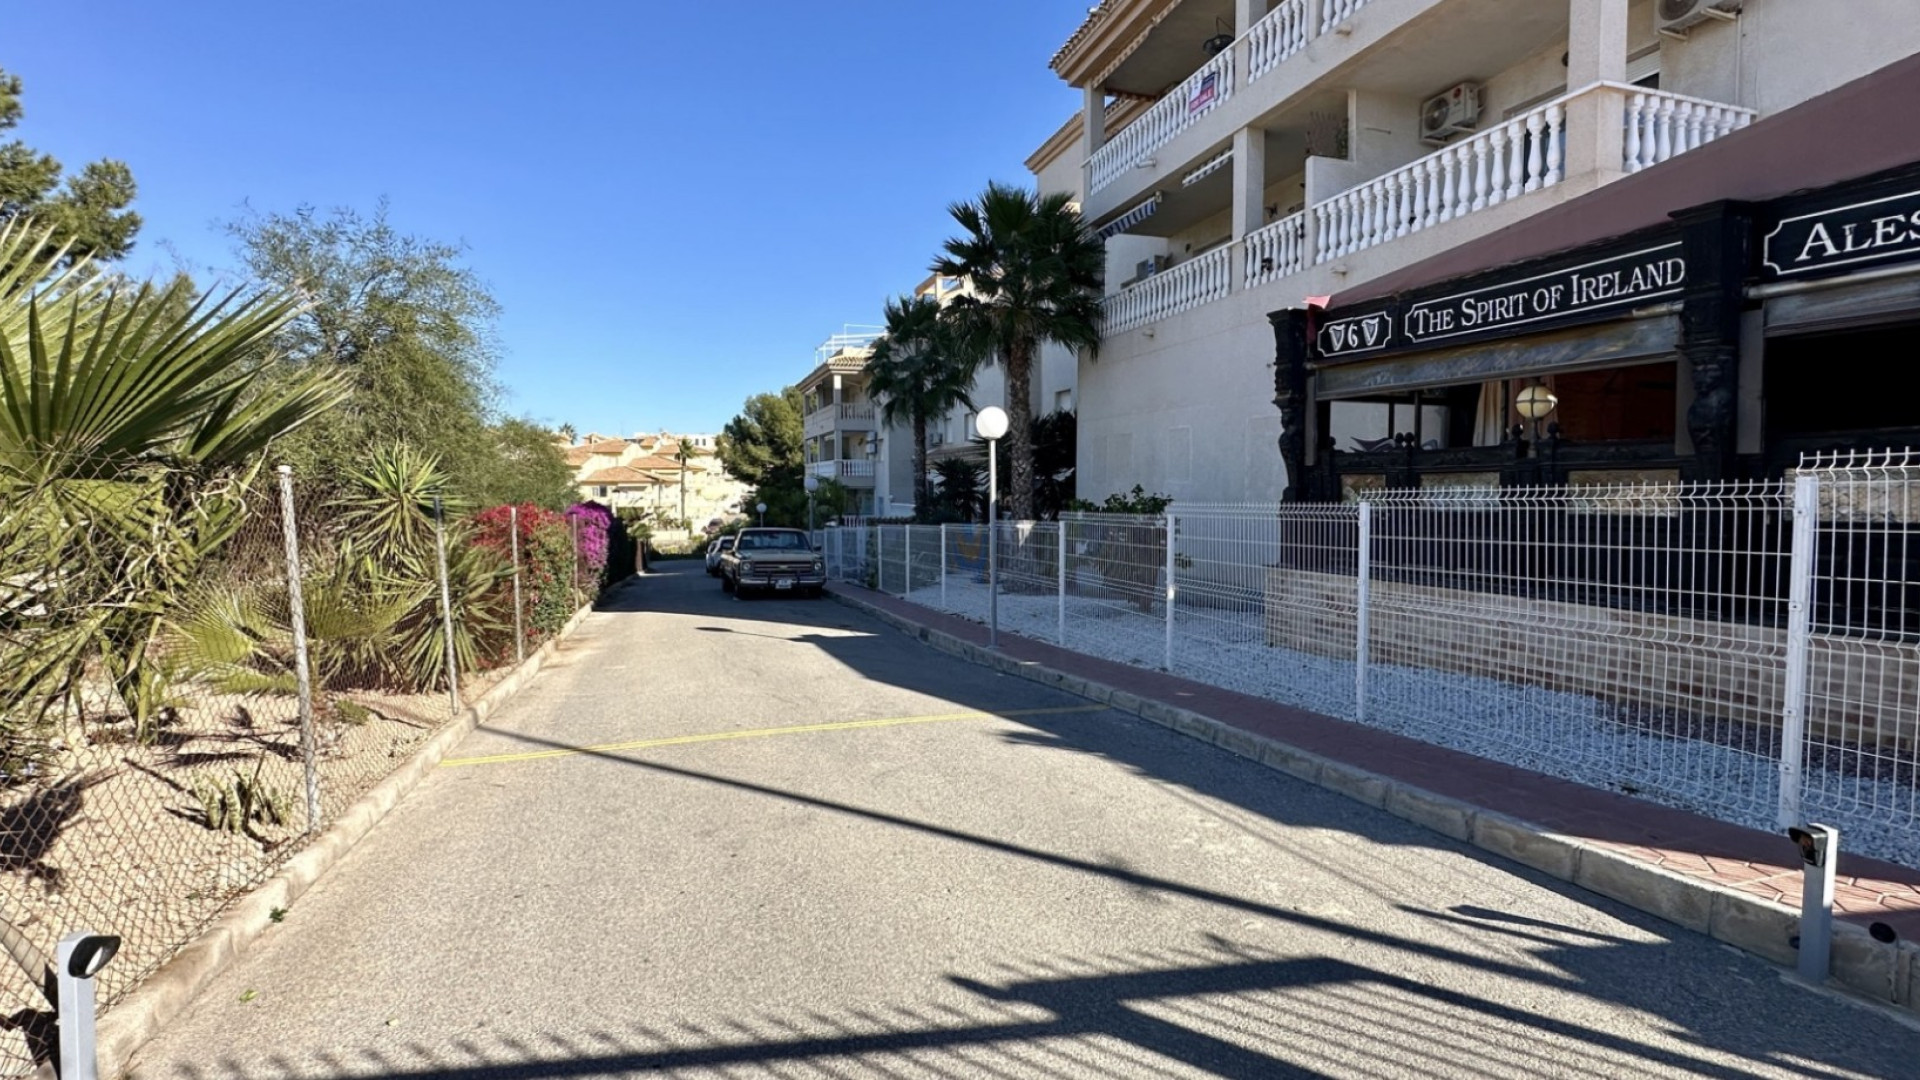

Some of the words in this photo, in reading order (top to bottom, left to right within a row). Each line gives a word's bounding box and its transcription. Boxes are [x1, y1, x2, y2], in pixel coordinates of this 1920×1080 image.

[1414, 307, 1455, 336] THE
[1461, 291, 1529, 327] SPIRIT
[1532, 284, 1565, 312] OF
[1570, 257, 1686, 305] IRELAND
[1347, 320, 1358, 348] 6
